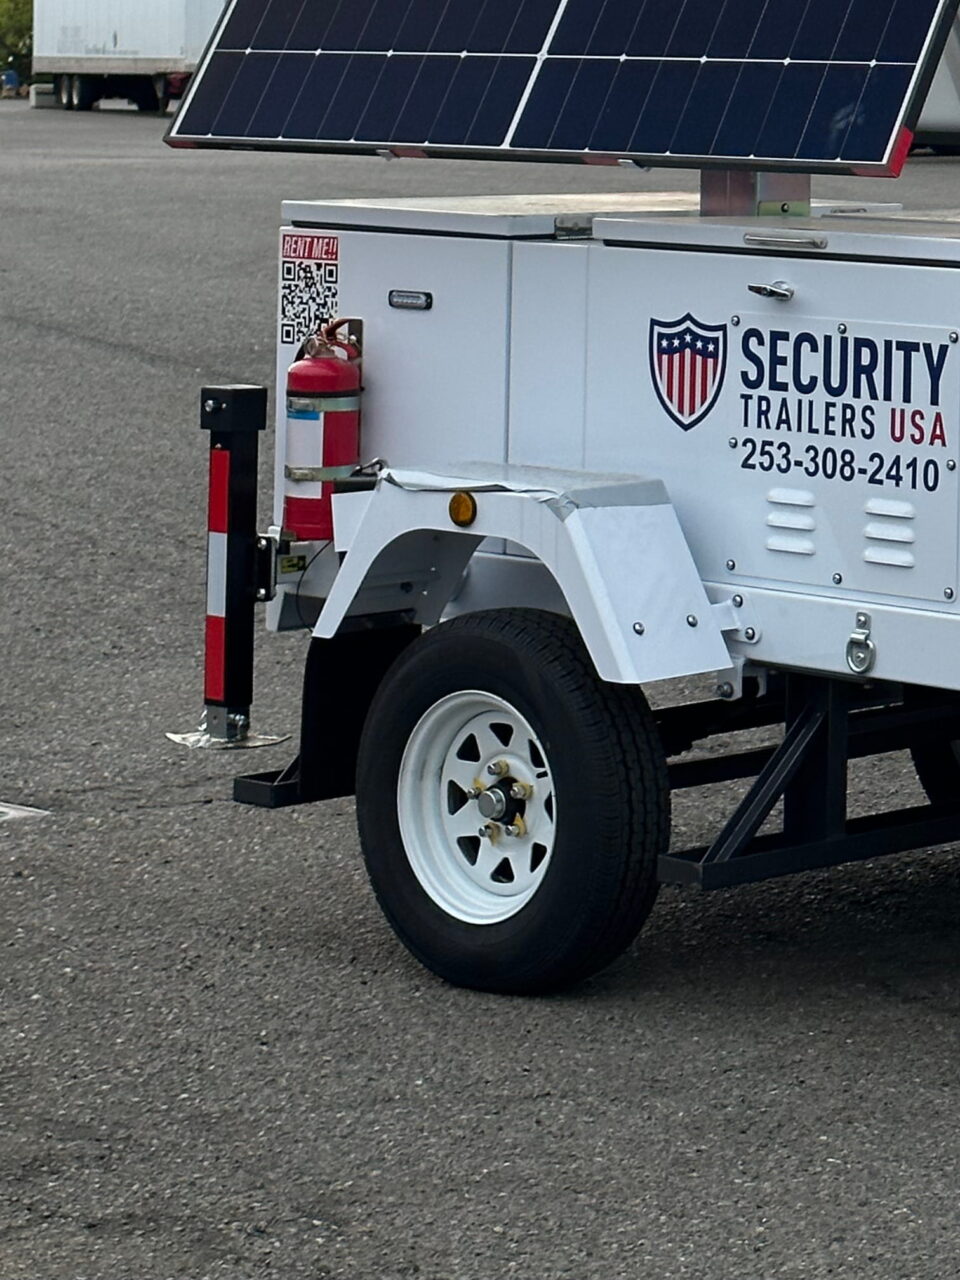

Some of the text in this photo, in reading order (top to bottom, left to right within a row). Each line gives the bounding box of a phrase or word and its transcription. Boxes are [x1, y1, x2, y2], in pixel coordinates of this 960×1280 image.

[283, 236, 338, 259] RENT ME!!
[740, 327, 949, 406] SECURITY
[740, 393, 947, 448] TRAILERS USA
[741, 437, 940, 492] 253-308-2410
